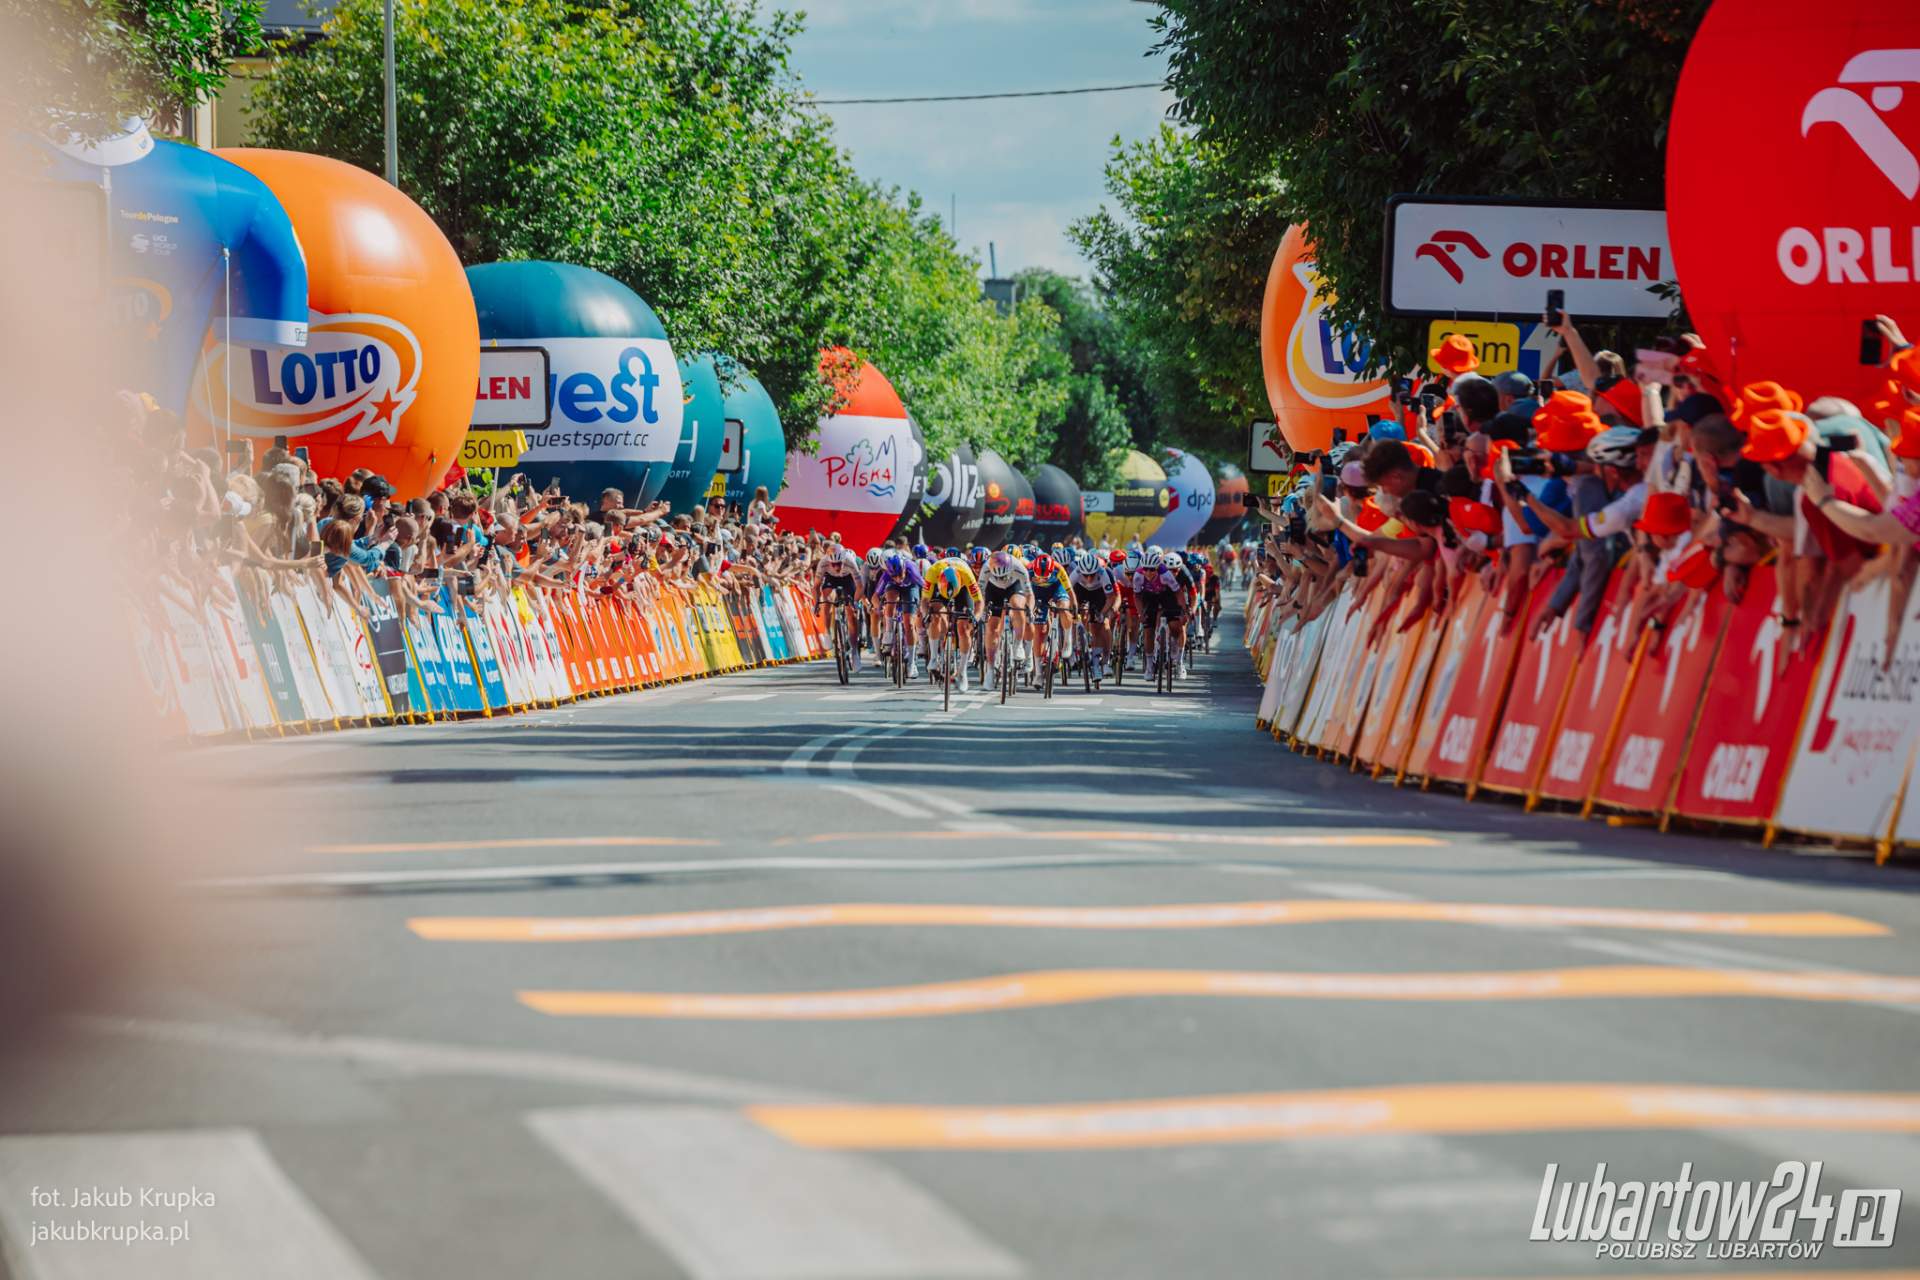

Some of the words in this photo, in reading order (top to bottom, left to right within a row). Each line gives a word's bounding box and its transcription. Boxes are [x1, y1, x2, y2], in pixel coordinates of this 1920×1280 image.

[1503, 242, 1660, 281] ORLEN
[250, 344, 381, 405] LOTTO
[476, 376, 531, 400] LEN
[464, 439, 513, 459] 50m
[1187, 488, 1212, 512] dpd
